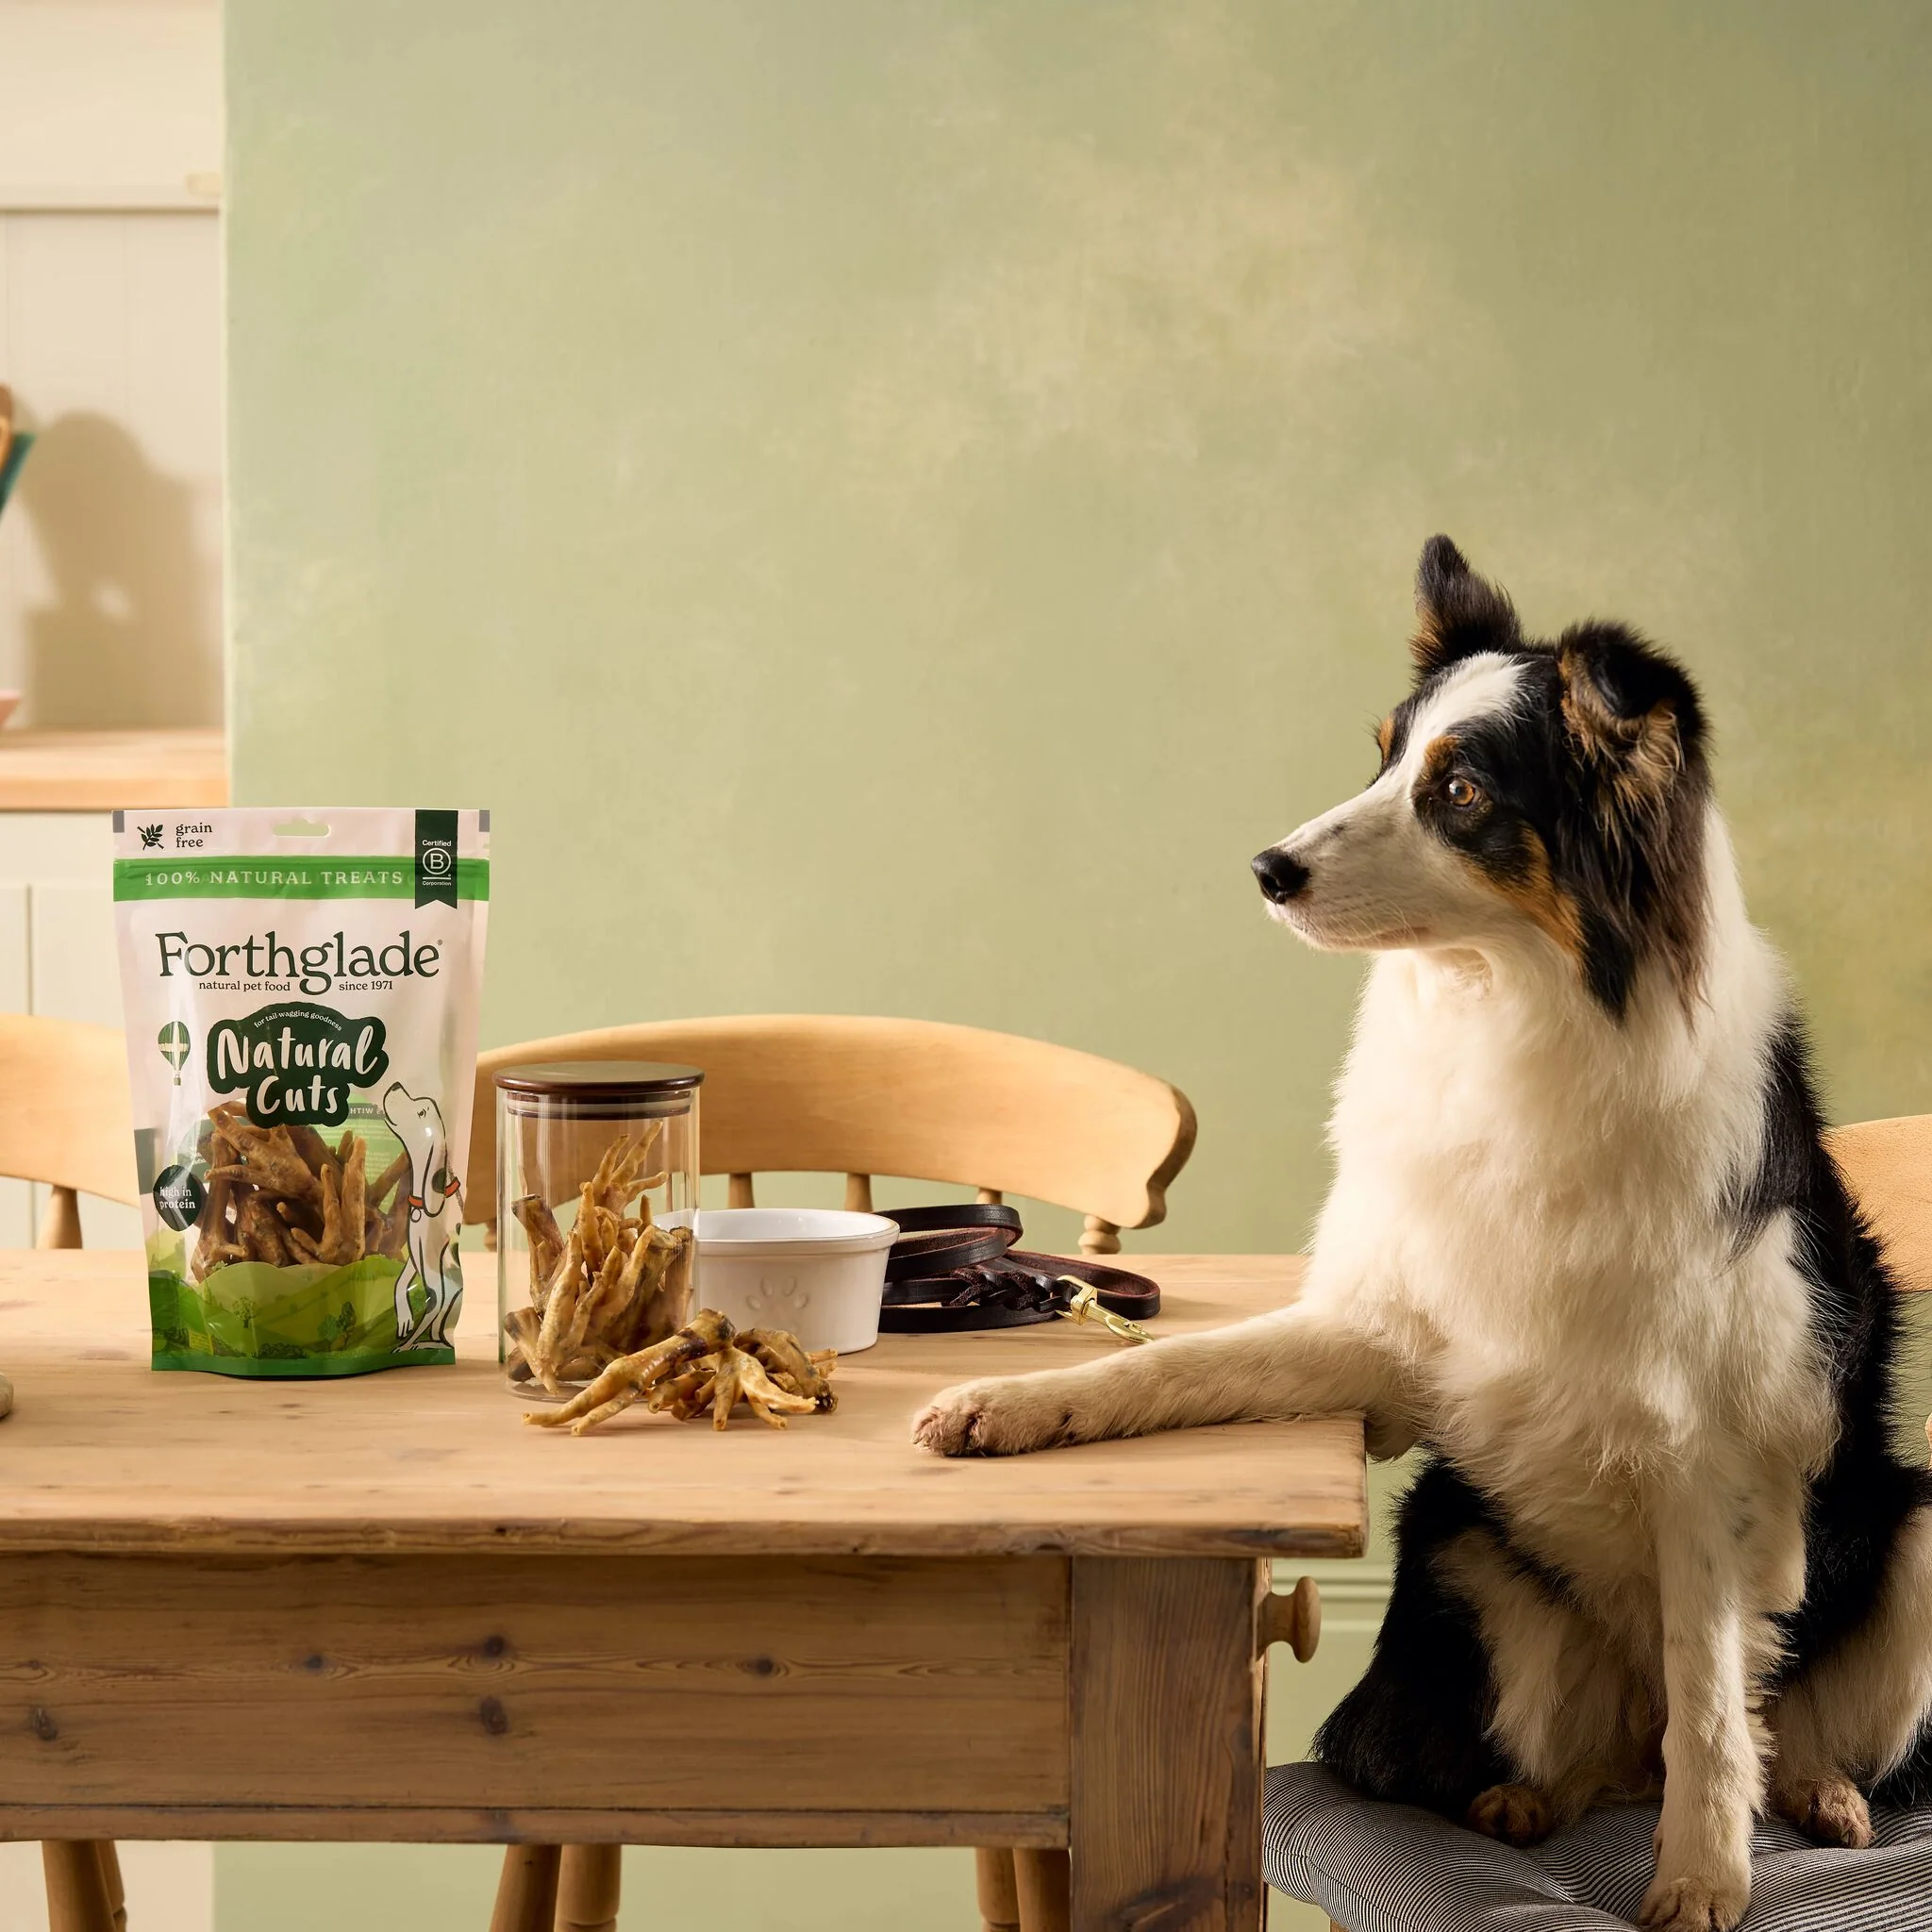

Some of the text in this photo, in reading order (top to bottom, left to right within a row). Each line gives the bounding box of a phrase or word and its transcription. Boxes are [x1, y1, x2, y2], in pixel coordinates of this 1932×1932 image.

[175, 823, 213, 836] grain
[175, 837, 204, 848] free
[430, 853, 444, 869] B
[145, 871, 403, 885] 100% NATURAL TREATS
[156, 929, 440, 995] Forthglade
[199, 981, 291, 991] natural pet food
[339, 981, 393, 991] since 1971
[253, 1019, 265, 1028] for
[309, 1012, 342, 1031] goodness
[217, 1024, 378, 1080] Natural
[256, 1074, 340, 1115] Cuts
[159, 1186, 192, 1198] high in
[159, 1199, 196, 1210] protein
